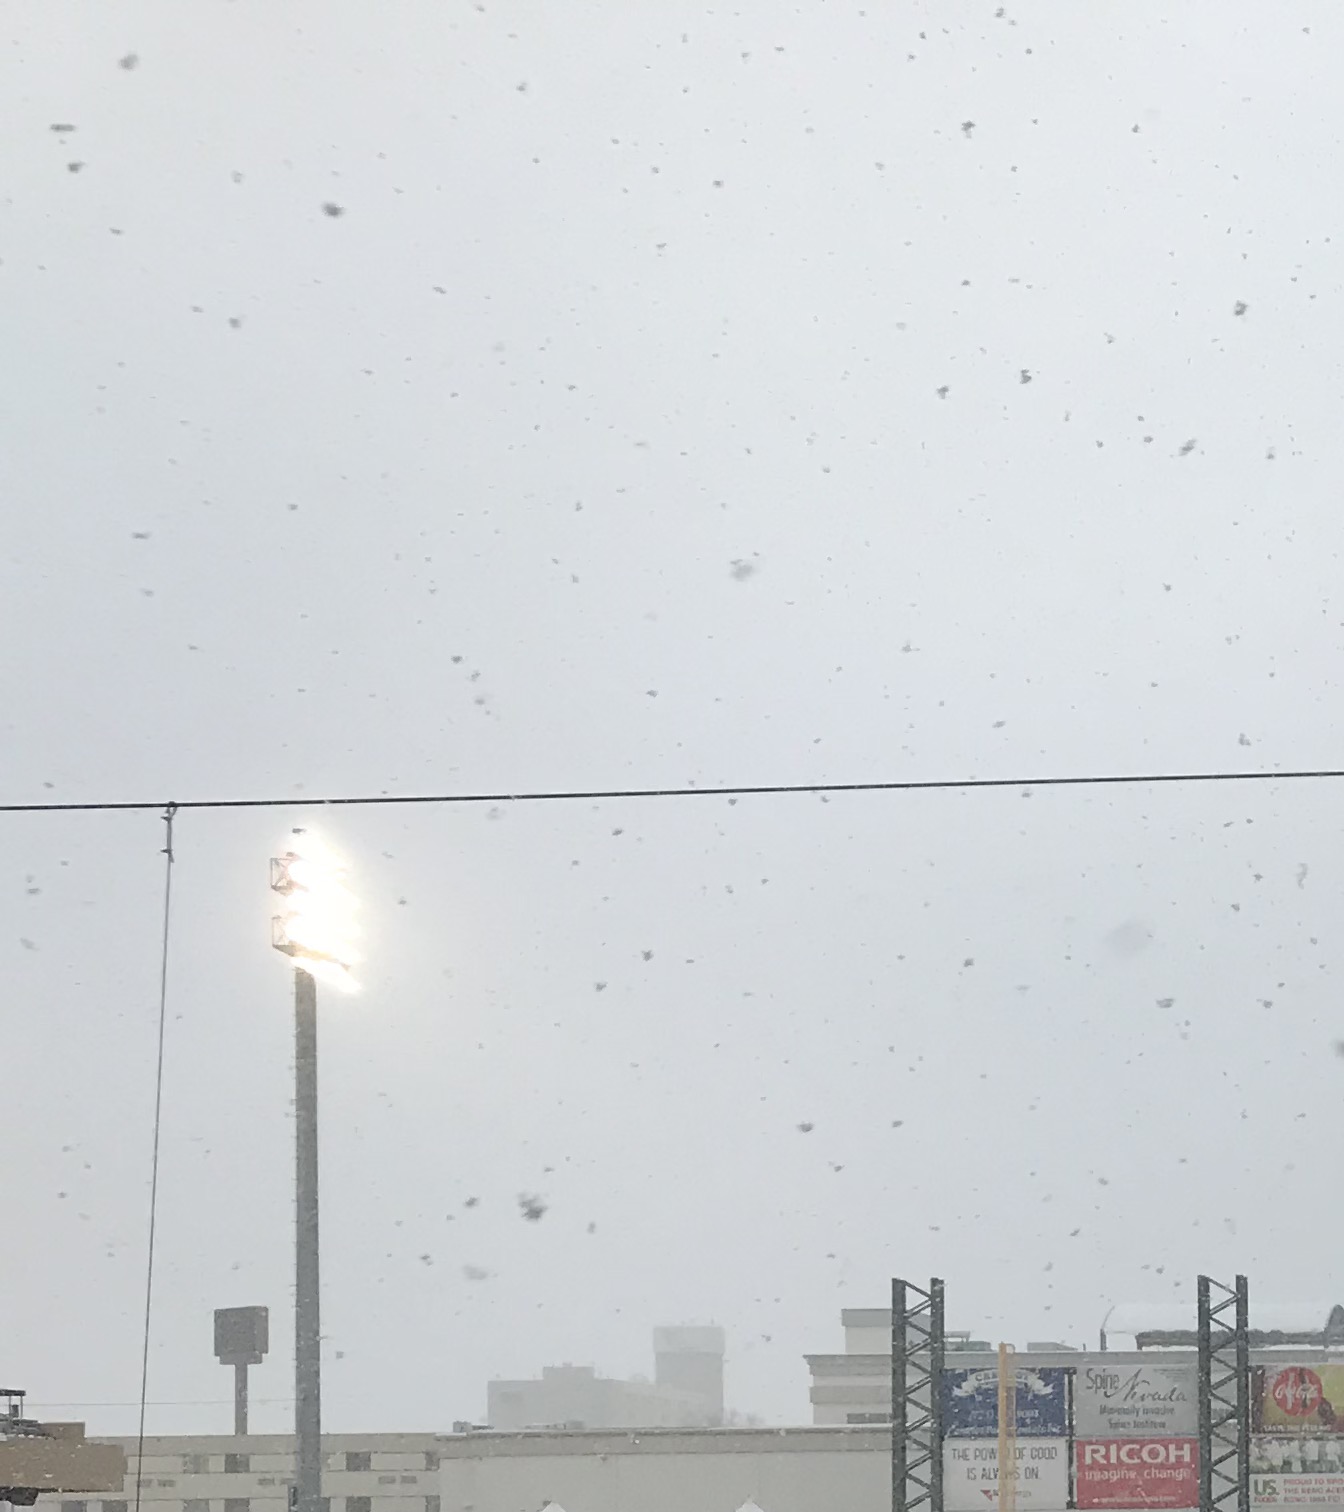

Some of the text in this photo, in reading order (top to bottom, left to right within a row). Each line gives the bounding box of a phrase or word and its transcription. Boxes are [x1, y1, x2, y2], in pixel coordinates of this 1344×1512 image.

[1086, 1367, 1120, 1394] Spine
[1103, 1367, 1188, 1402] Nevada
[951, 1447, 970, 1461] THE
[1030, 1446, 1058, 1460] GOOD
[1084, 1443, 1191, 1466] RICOH
[966, 1467, 977, 1481] IS
[981, 1466, 1021, 1481] ALWYS
